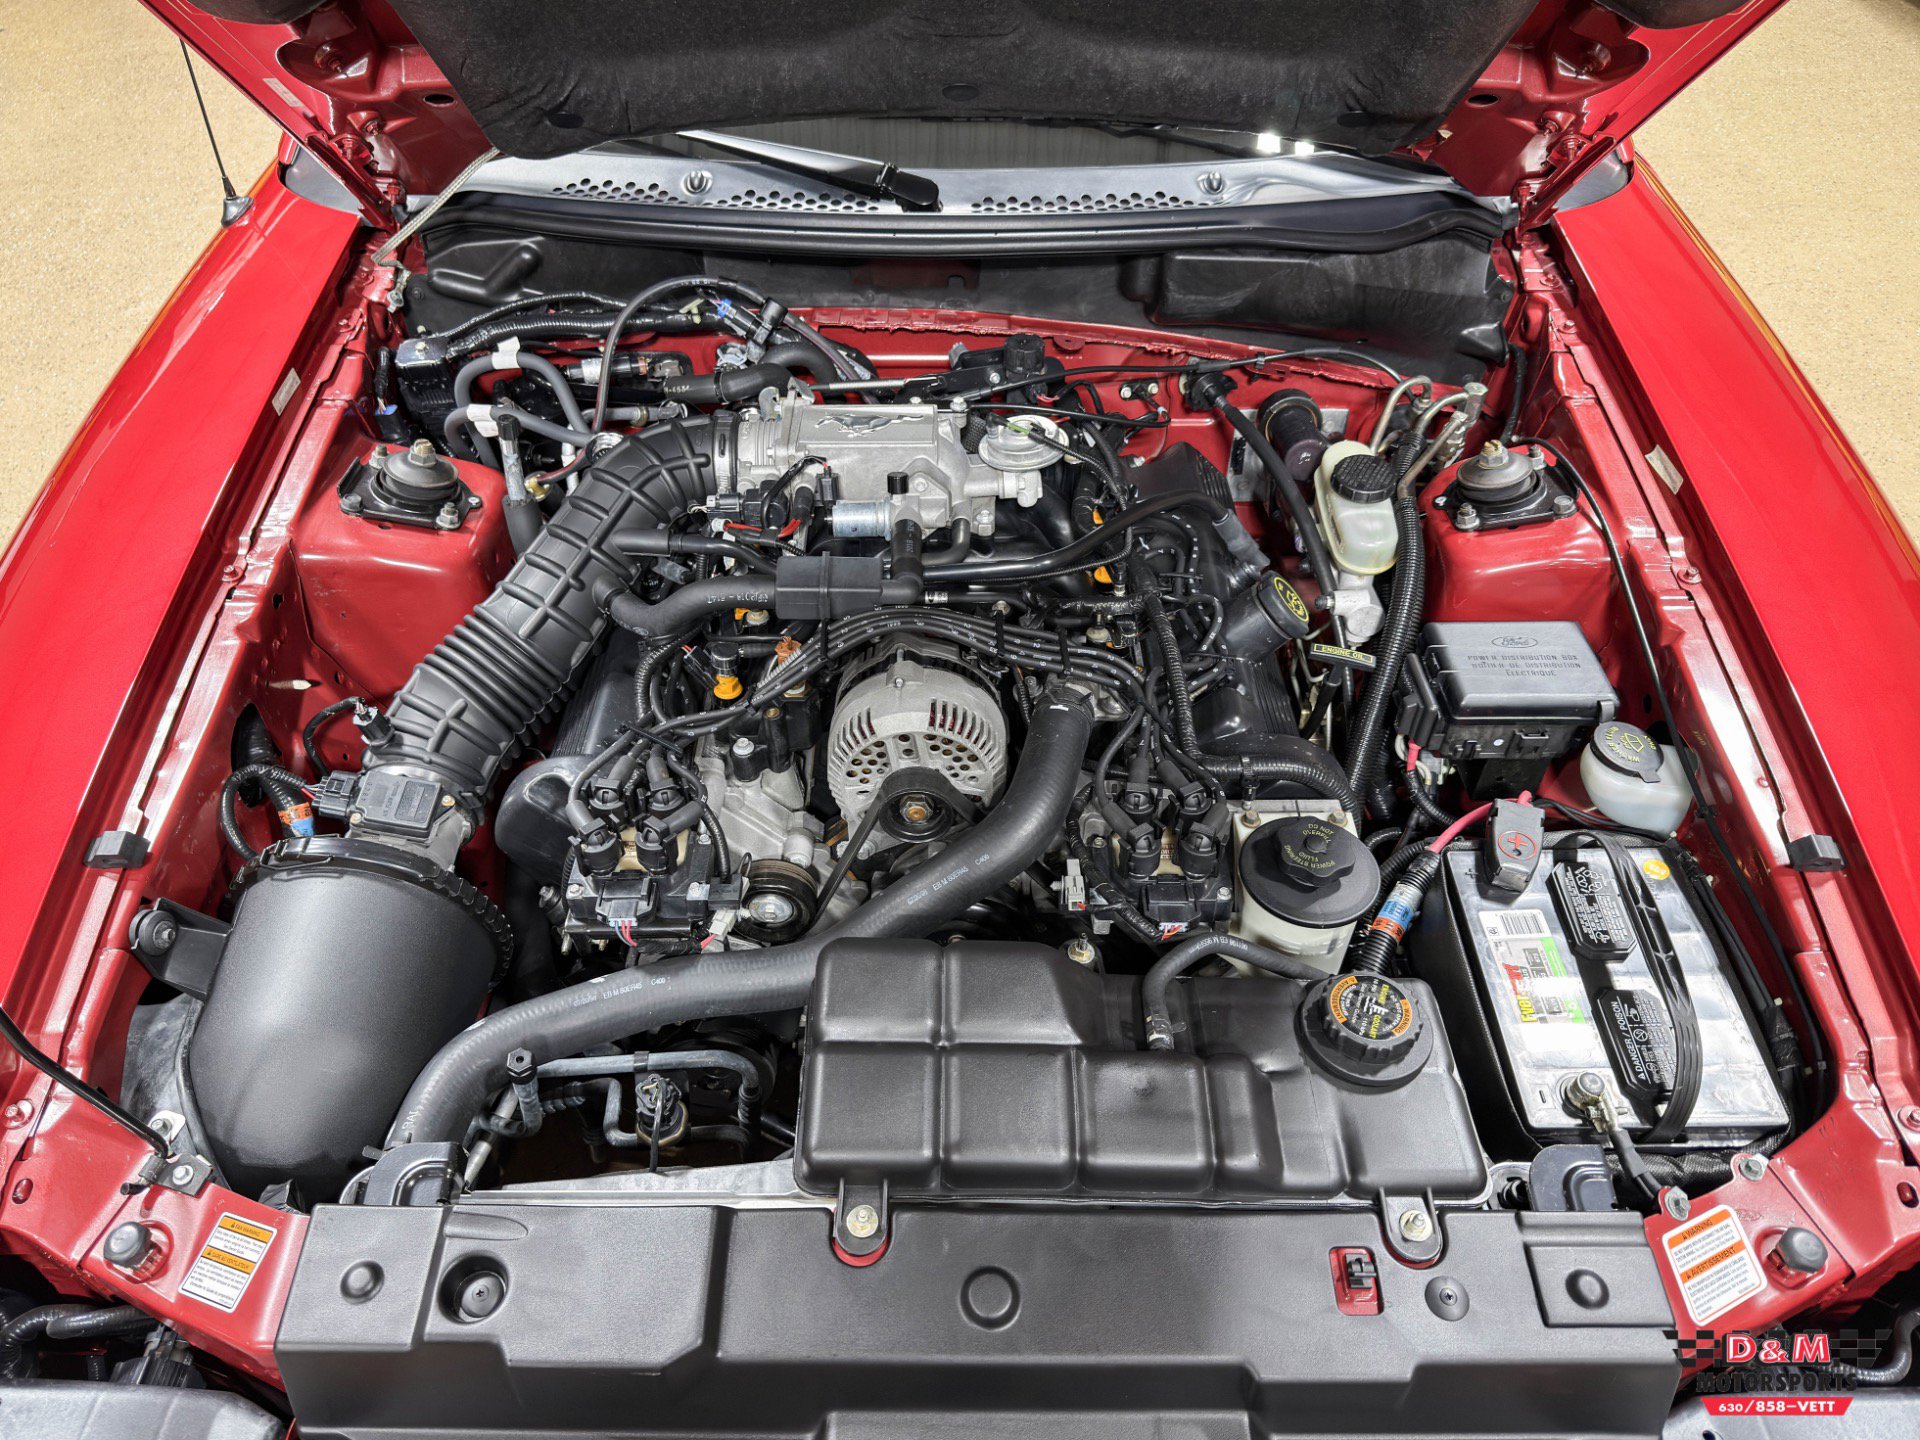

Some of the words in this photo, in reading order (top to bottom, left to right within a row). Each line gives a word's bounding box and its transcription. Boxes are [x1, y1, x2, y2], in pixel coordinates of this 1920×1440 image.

[1322, 645, 1350, 657] ENGINE
[1352, 651, 1363, 660] OIL
[1302, 830, 1332, 844] OVERFILL
[1320, 825, 1334, 835] NOT
[1284, 844, 1309, 867] STEERING
[1298, 851, 1319, 862] FLUID
[1310, 860, 1336, 869] POWER
[1369, 1014, 1382, 1039] COOLANT
[1394, 1008, 1410, 1034] WARNING
[1611, 1001, 1628, 1031] POISON
[1625, 1038, 1643, 1072] DANGER
[1686, 1218, 1713, 1238] WARNING
[1691, 1246, 1736, 1275] AVERTISSEMENT
